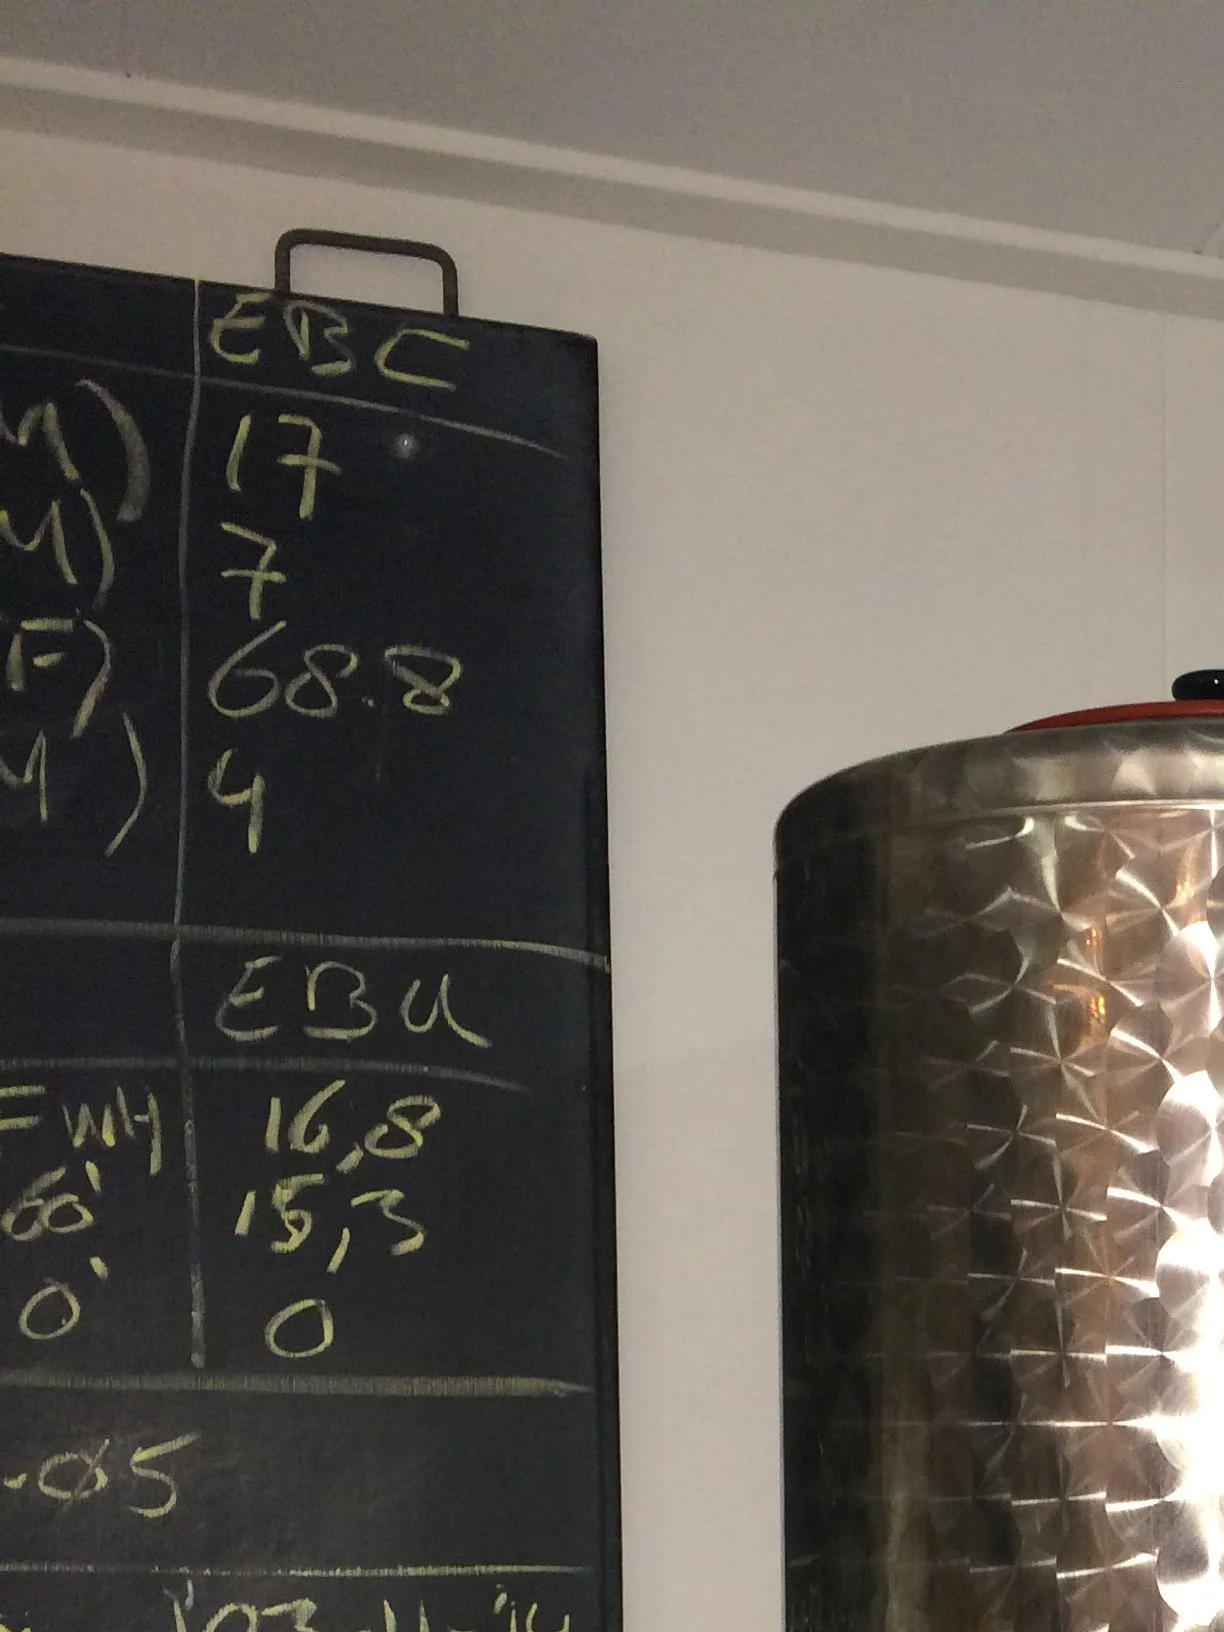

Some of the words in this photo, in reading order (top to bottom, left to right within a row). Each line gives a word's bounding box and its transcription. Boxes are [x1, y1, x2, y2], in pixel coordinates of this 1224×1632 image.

[209, 292, 470, 392] EBC
[225, 413, 343, 520] 17
[220, 521, 287, 621] 7
[208, 620, 464, 718] 68.8
[208, 748, 266, 854] 4
[215, 956, 494, 1049] EBU
[234, 1173, 425, 1274] 15,3
[265, 1298, 334, 1358] 0
